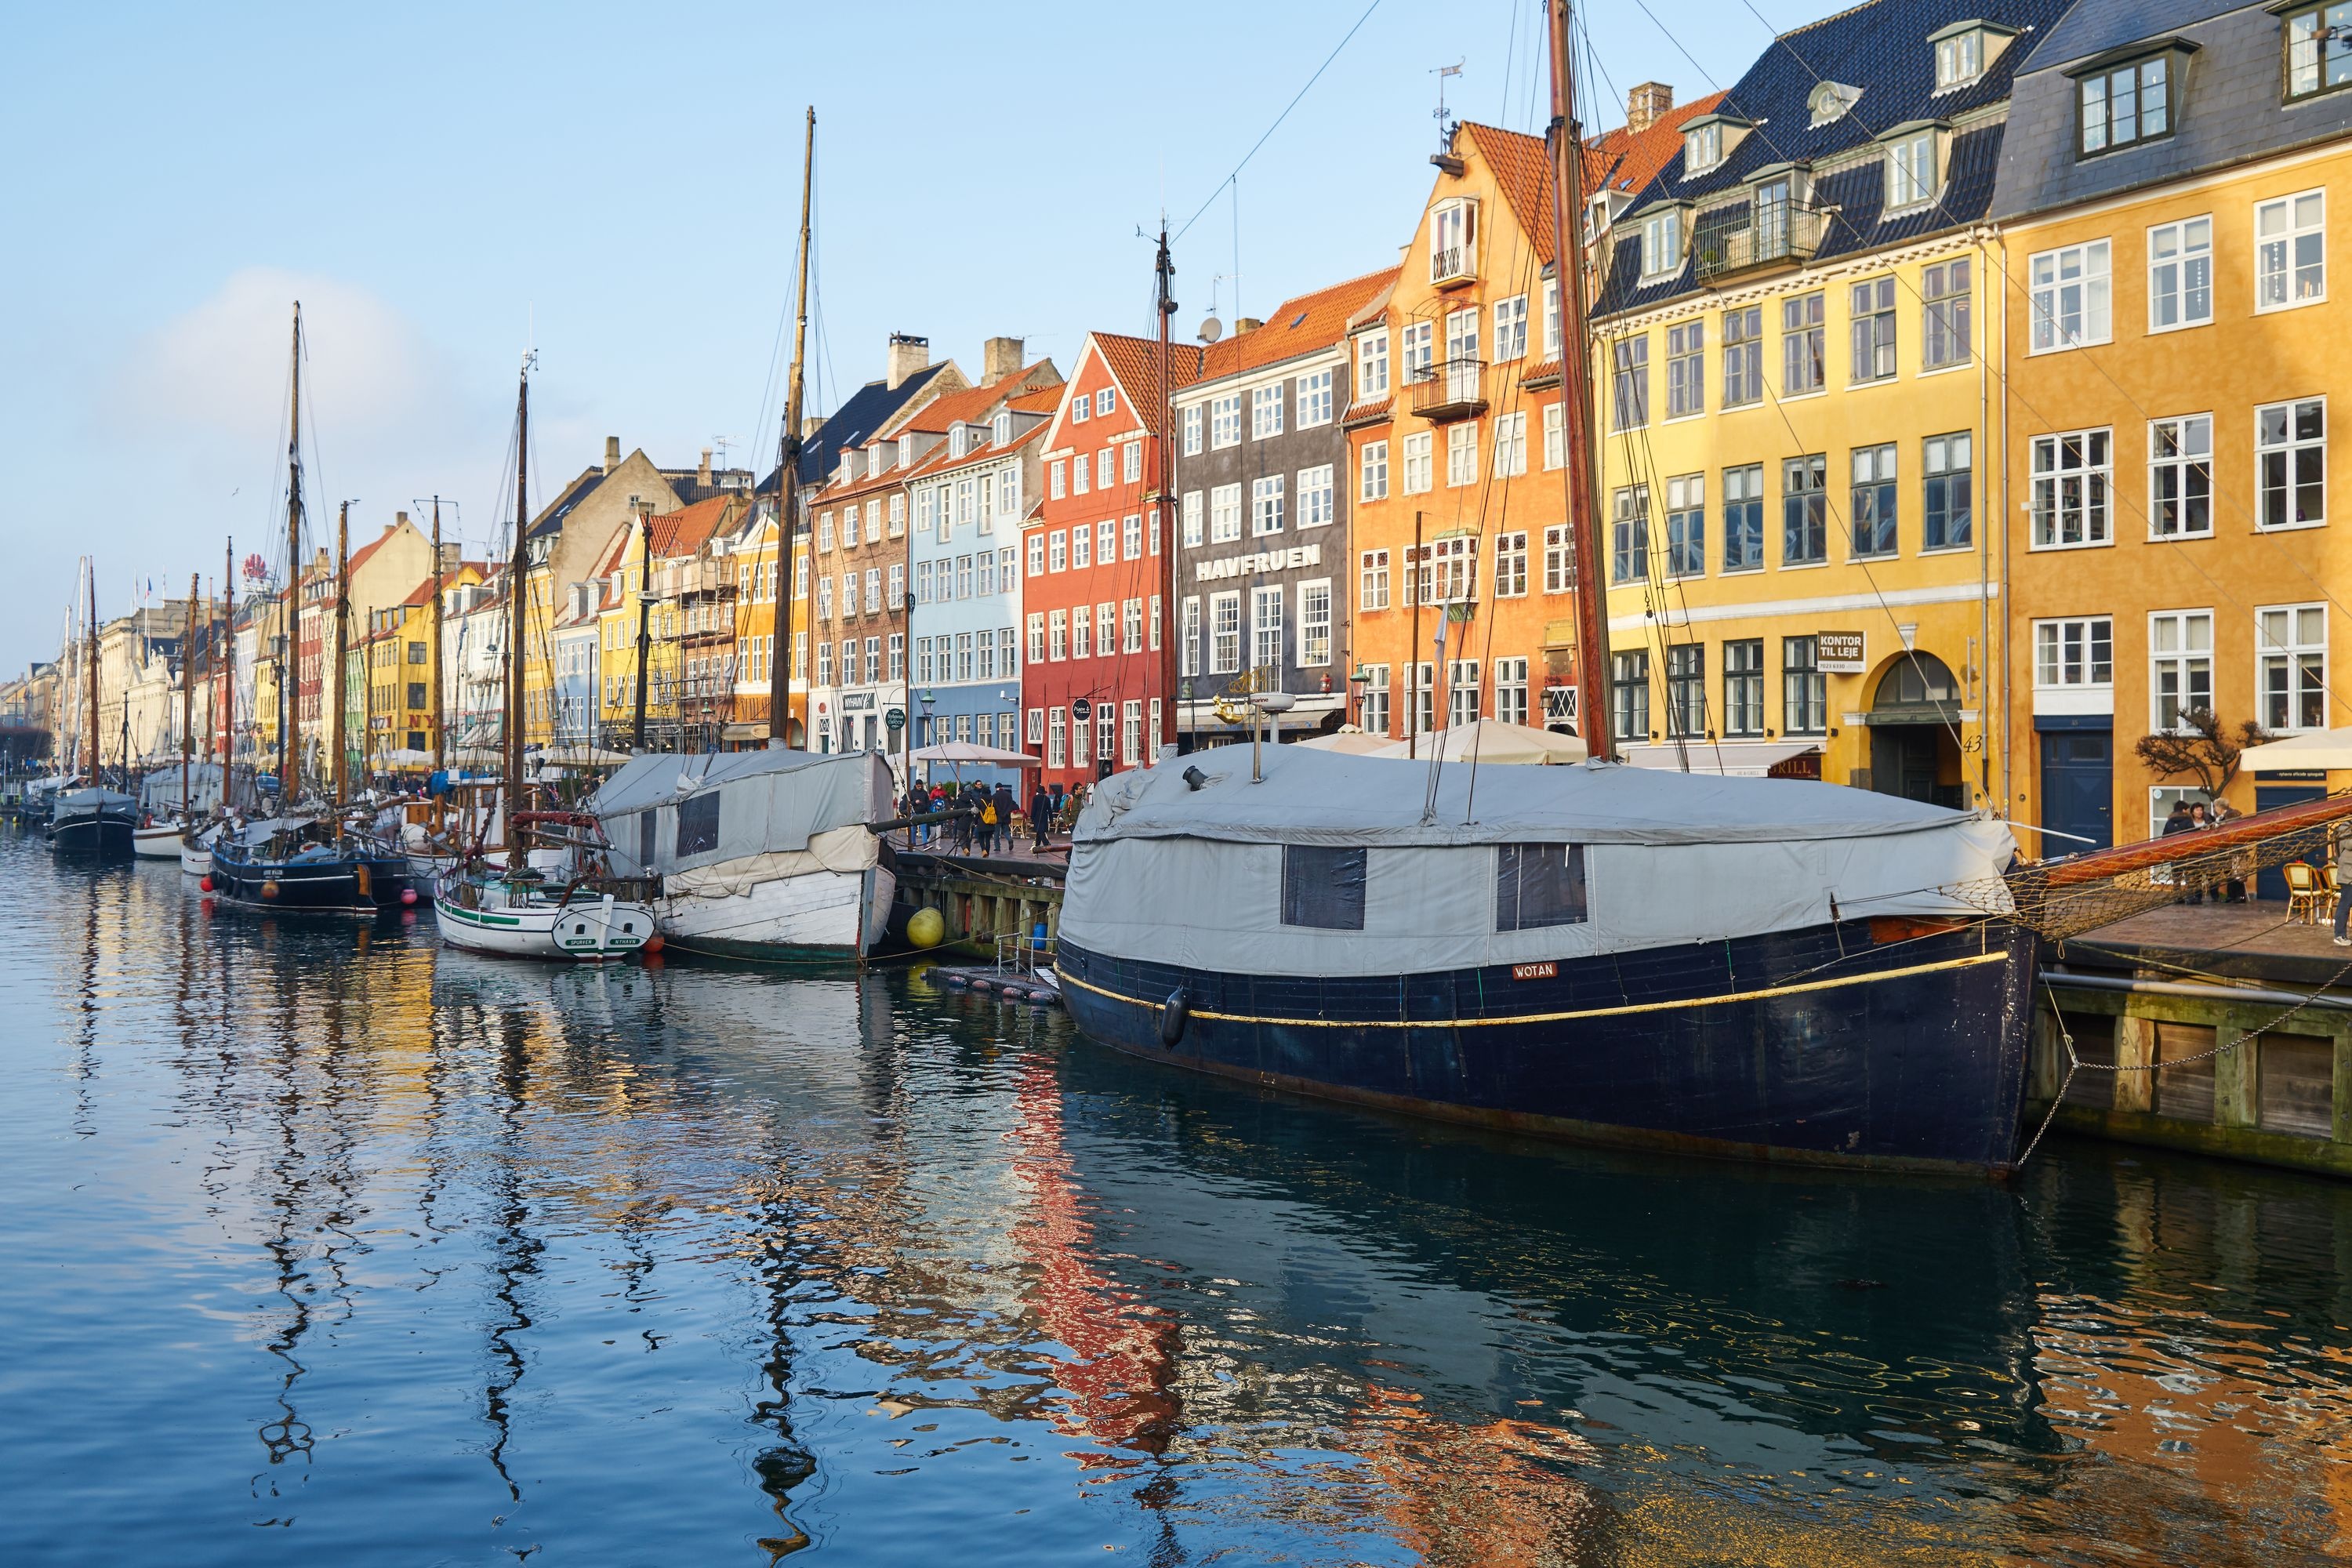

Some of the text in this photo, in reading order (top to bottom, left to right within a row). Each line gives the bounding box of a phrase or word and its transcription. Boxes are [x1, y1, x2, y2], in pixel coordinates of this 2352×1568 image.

[1196, 544, 1320, 582] HAVFRUEN
[1820, 636, 1862, 646] KONTOR
[1820, 647, 1859, 659] TIL LEJE
[1962, 735, 1983, 753] 43
[1515, 964, 1553, 978] WOTAN
